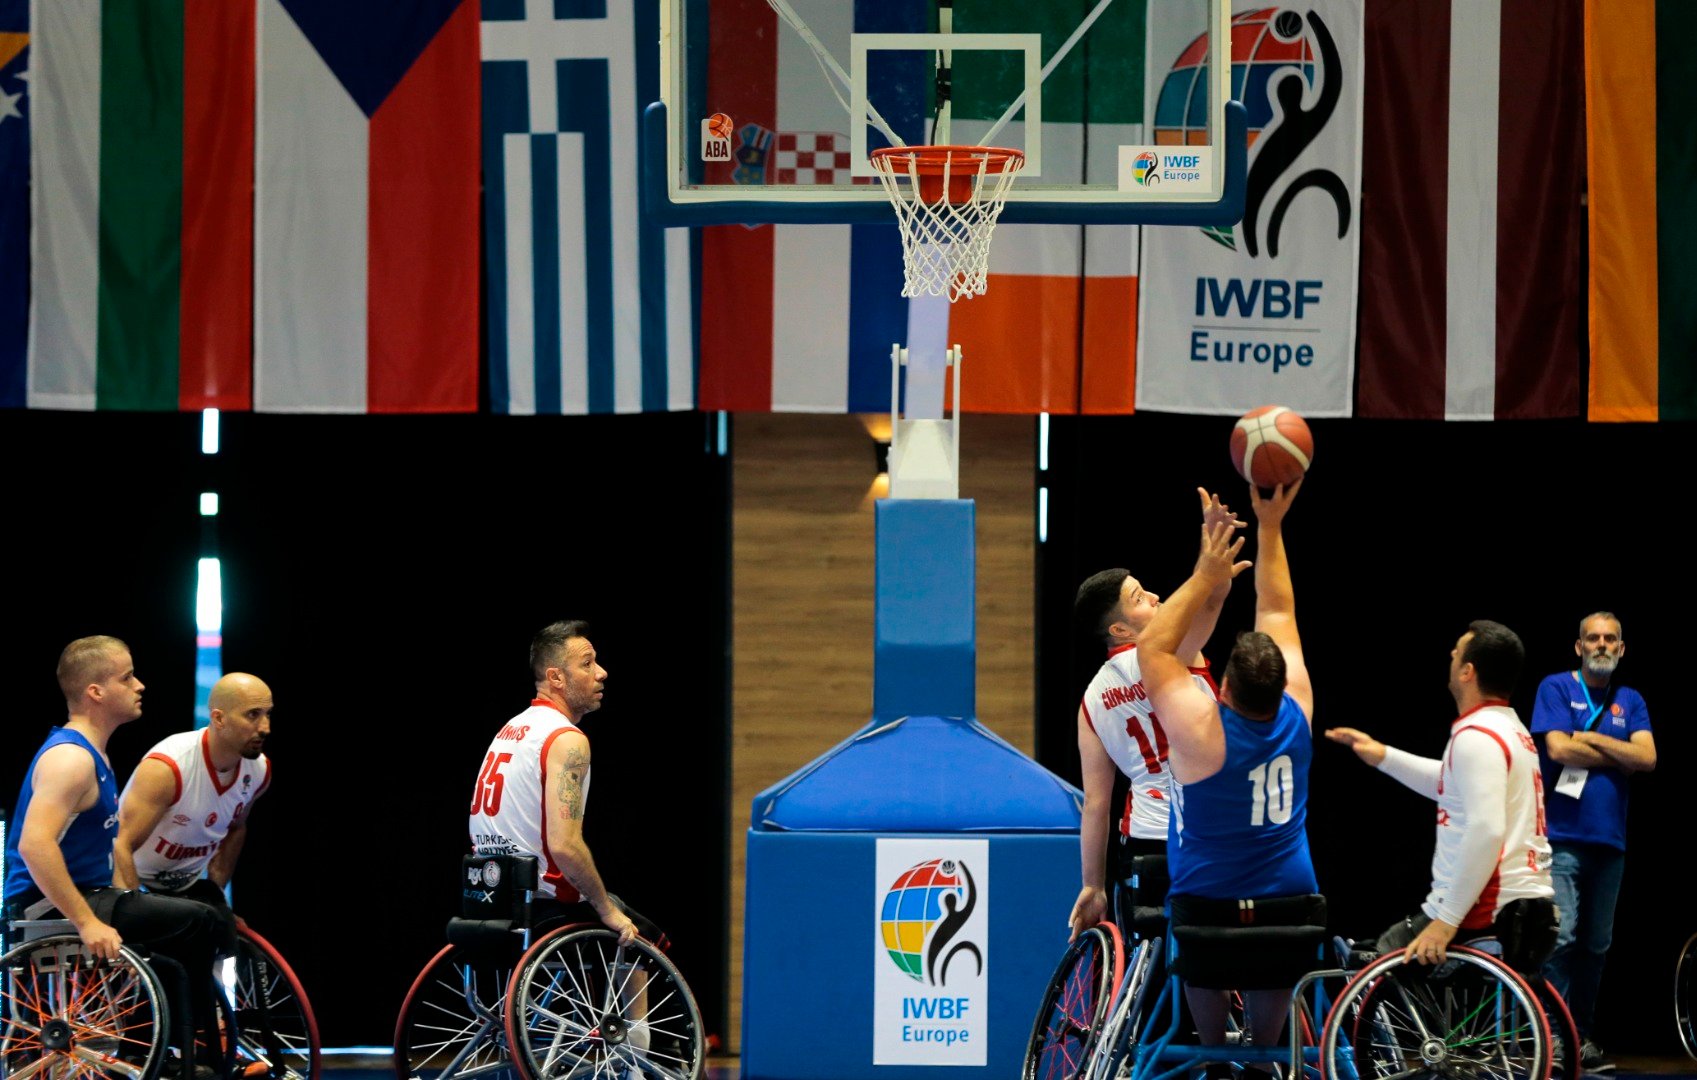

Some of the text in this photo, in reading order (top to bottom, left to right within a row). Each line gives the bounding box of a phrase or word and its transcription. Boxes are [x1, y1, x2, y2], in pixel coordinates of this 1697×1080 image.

[705, 141, 729, 158] ABA
[1164, 155, 1200, 168] IWBF
[1164, 170, 1200, 182] Europe
[1195, 277, 1323, 319] IWBF
[1190, 331, 1314, 373] Europe
[1248, 754, 1294, 826] 10
[903, 997, 969, 1019] IWBF
[903, 1025, 969, 1047] Europe
